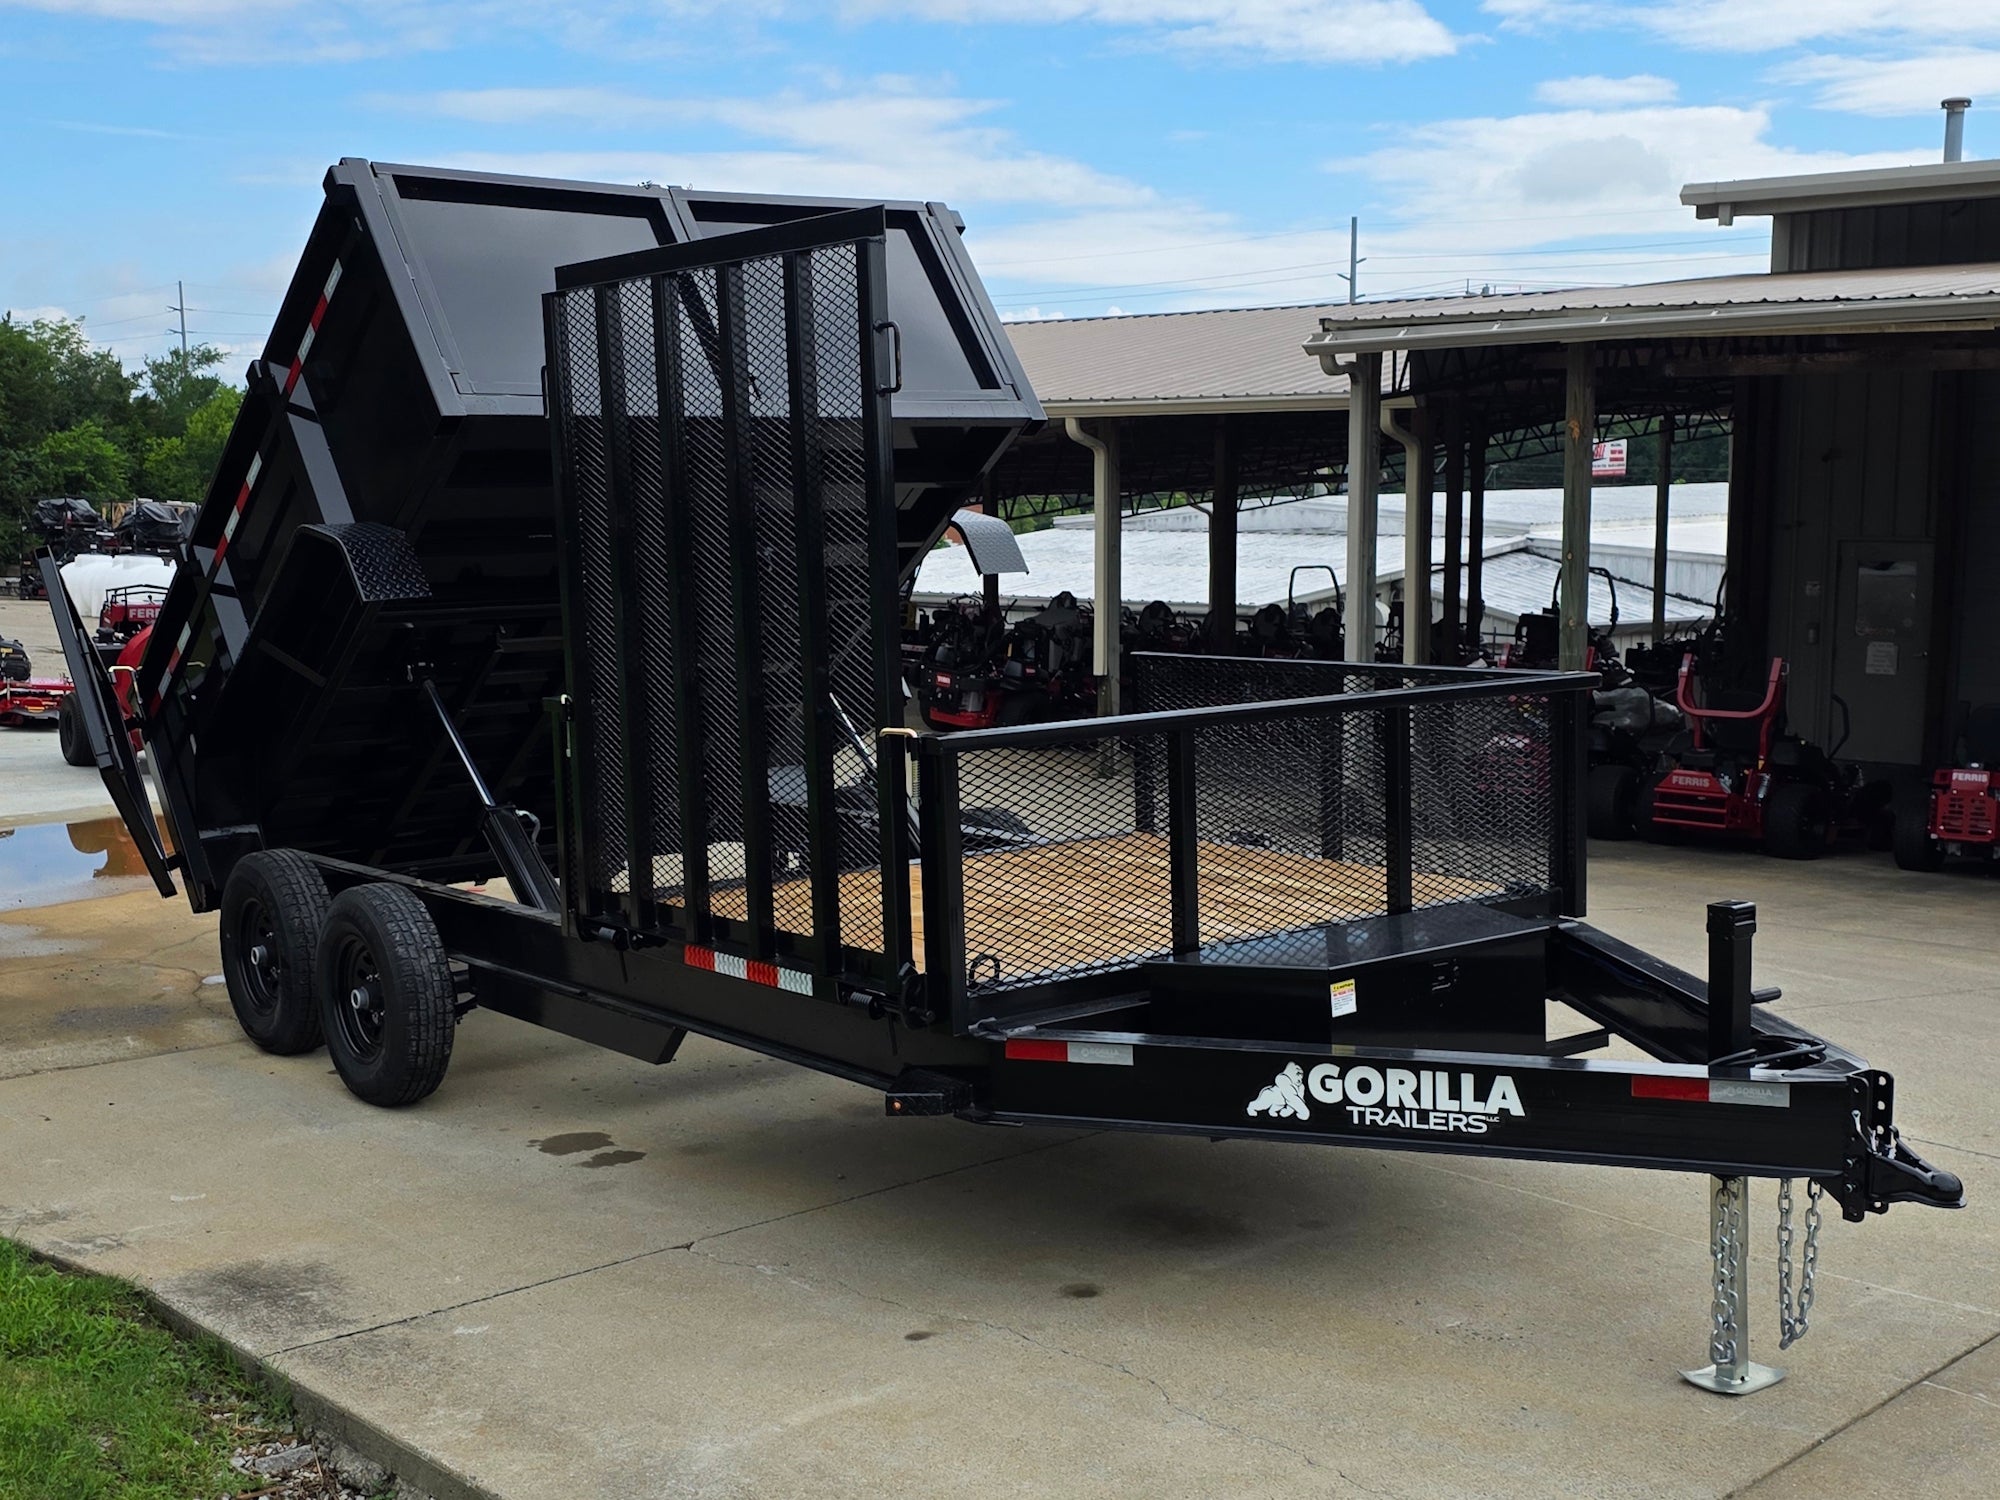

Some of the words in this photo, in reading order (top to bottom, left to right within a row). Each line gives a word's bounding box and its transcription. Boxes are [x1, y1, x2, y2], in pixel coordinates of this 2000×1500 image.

[1672, 775, 1710, 788] FERRIS
[1952, 772, 1988, 783] FERRIS
[1308, 1063, 1526, 1117] GORILLA
[1346, 1105, 1488, 1134] TRAILERS
[1486, 1115, 1500, 1123] LLC
